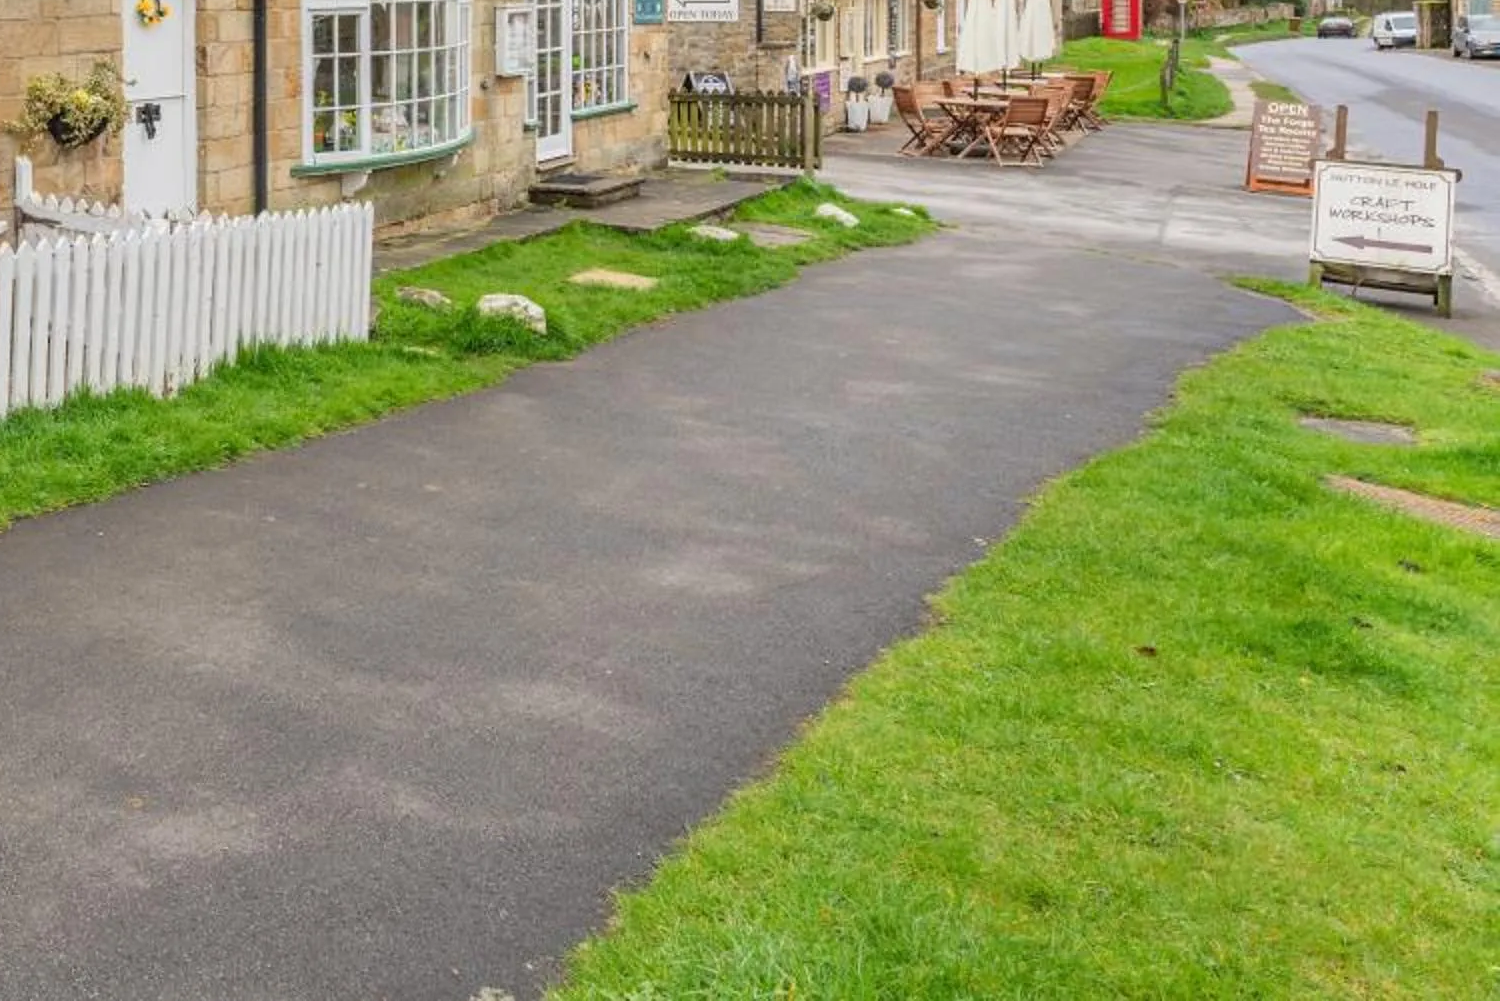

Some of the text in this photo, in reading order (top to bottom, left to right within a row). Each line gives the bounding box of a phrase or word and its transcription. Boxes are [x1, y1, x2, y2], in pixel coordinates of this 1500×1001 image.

[669, 10, 697, 20] OPEN
[701, 10, 735, 20] TODAY
[1268, 102, 1309, 117] OPEN
[1350, 196, 1416, 212] CRAFT
[1329, 206, 1436, 228] WORKSHOPS
